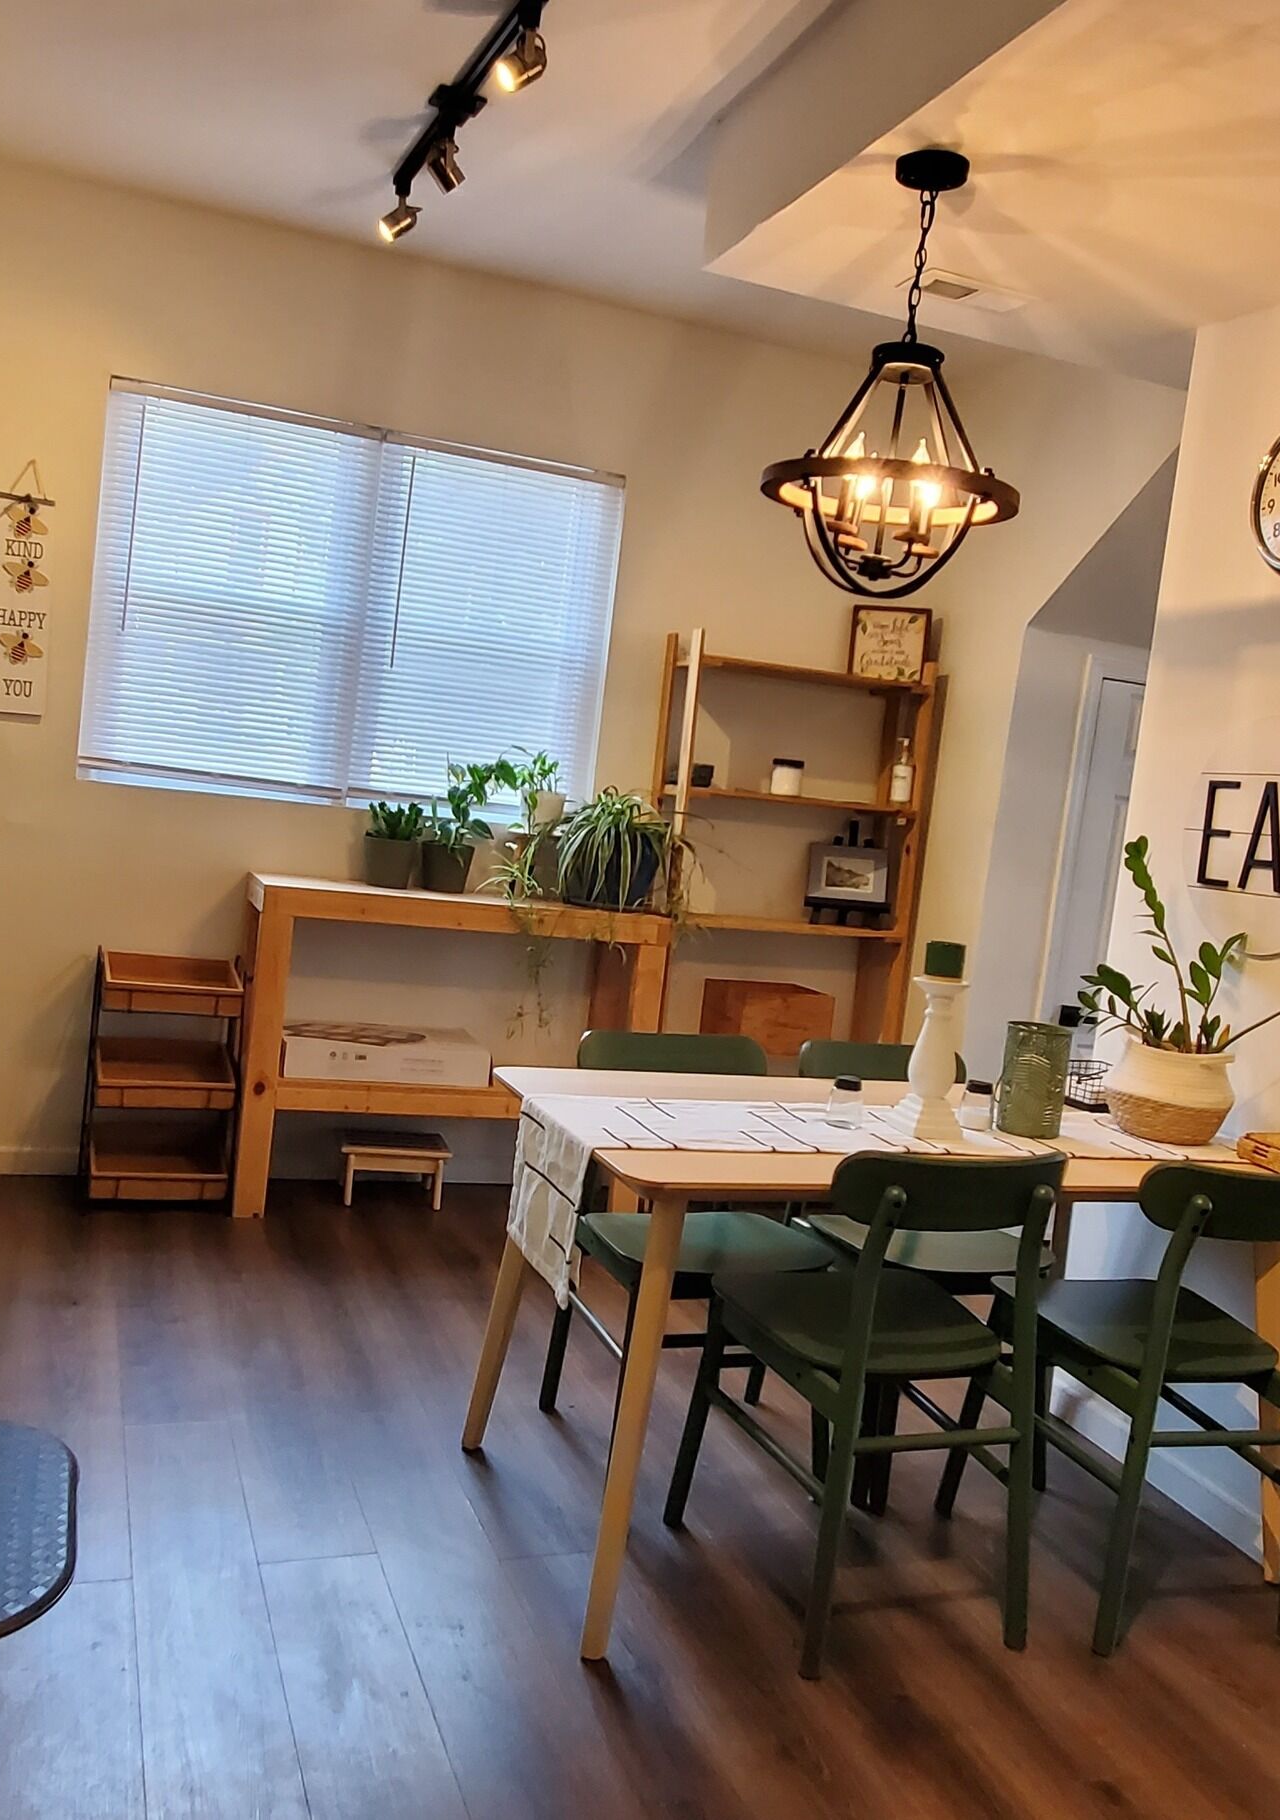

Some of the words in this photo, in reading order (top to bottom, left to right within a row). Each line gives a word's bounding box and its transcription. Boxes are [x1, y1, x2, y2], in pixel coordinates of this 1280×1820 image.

[1267, 499, 1276, 515] 9
[5, 538, 44, 560] KIND
[2, 677, 33, 698] YOU
